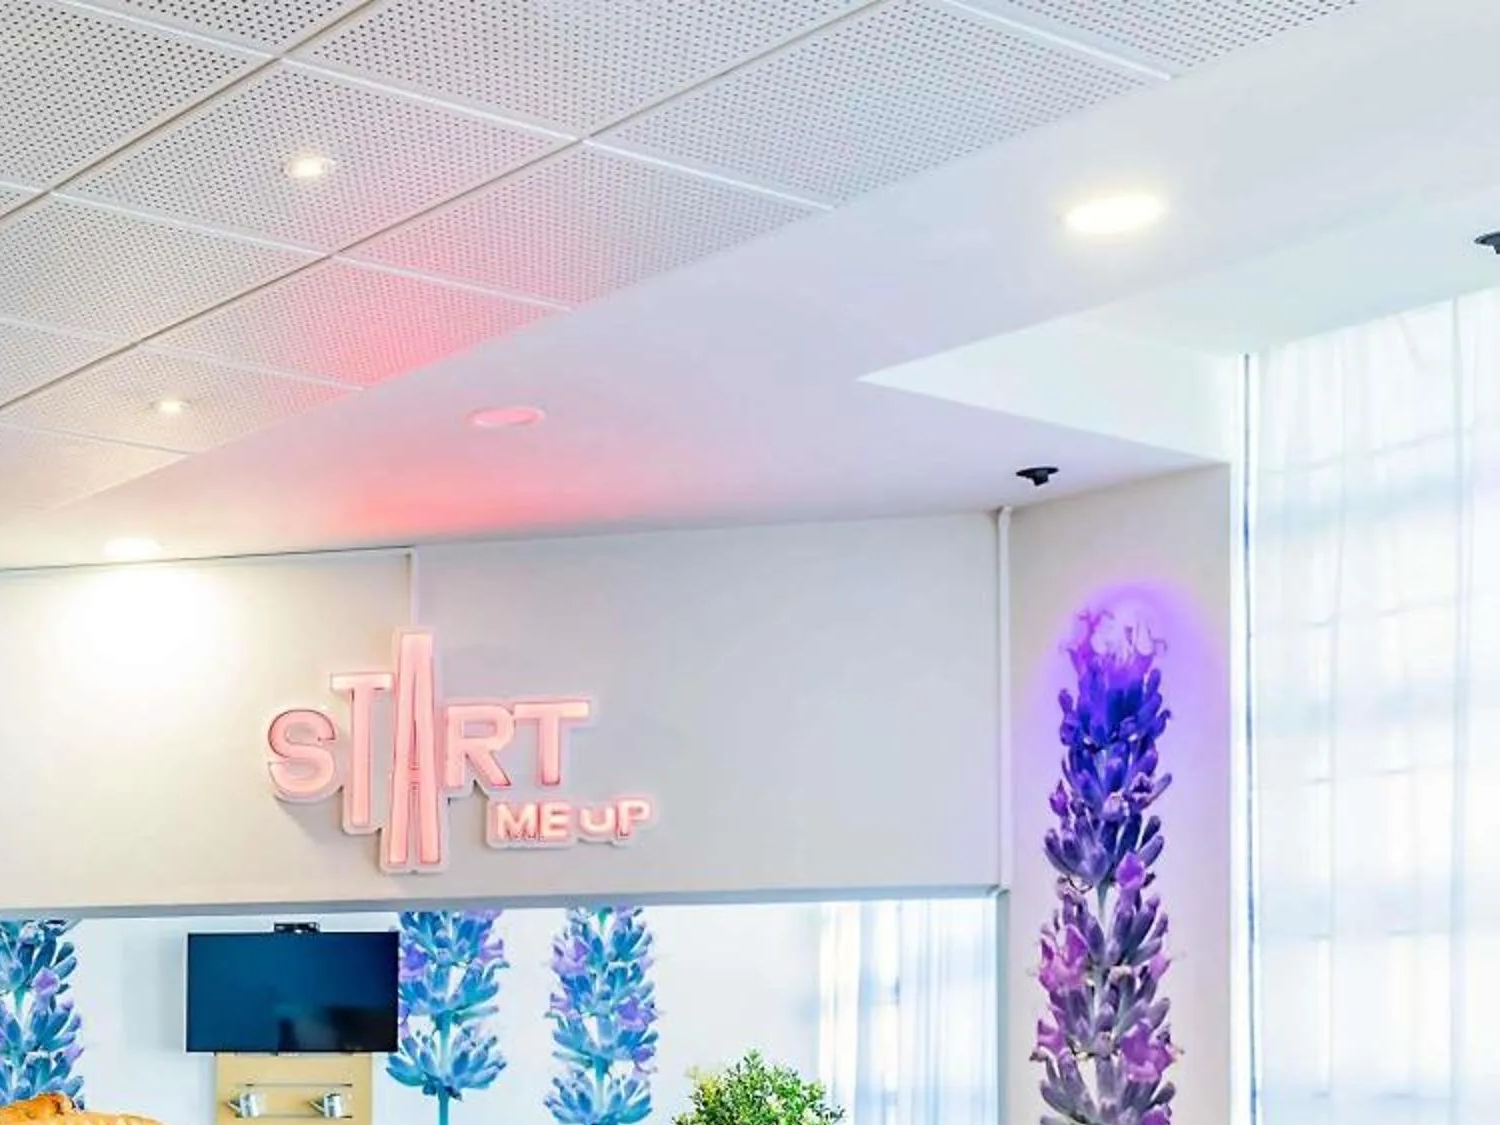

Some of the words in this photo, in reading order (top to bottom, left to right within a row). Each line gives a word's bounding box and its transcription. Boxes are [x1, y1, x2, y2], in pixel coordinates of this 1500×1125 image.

[267, 632, 591, 866] START
[496, 800, 570, 842] ME
[579, 798, 651, 839] UP
